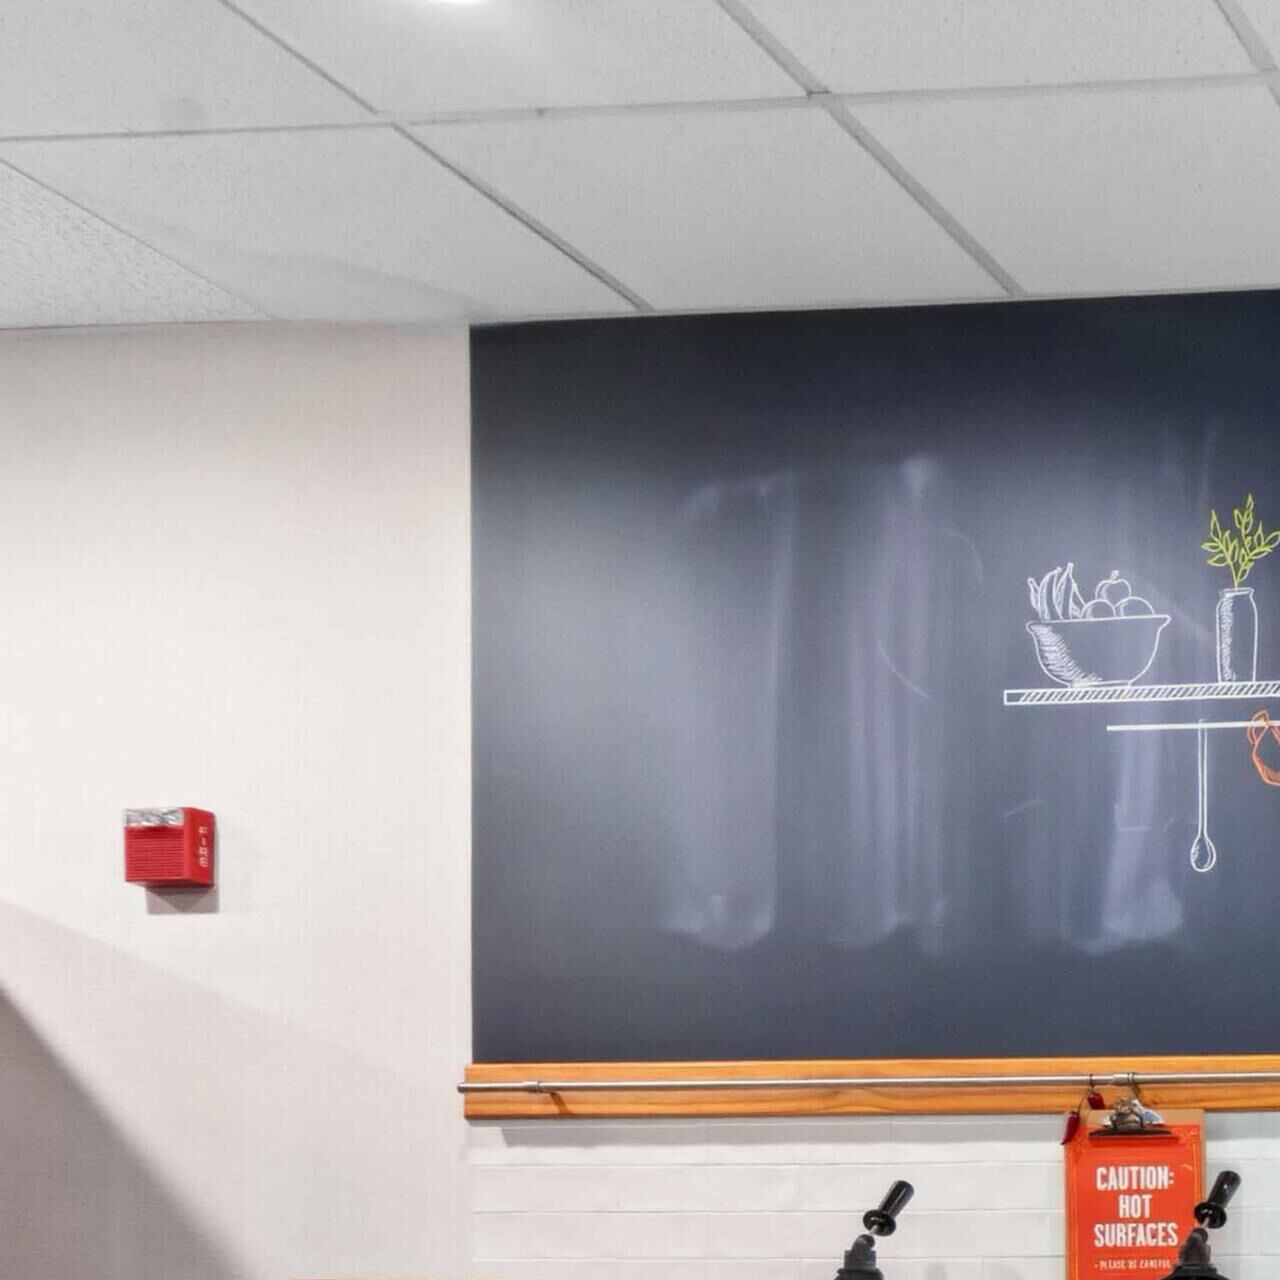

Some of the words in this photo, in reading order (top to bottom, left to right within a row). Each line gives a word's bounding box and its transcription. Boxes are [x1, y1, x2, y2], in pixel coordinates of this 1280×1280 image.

[1096, 1165, 1174, 1191] CAUTION:
[1119, 1195, 1152, 1219] HOT
[1094, 1223, 1179, 1248] SURFACES
